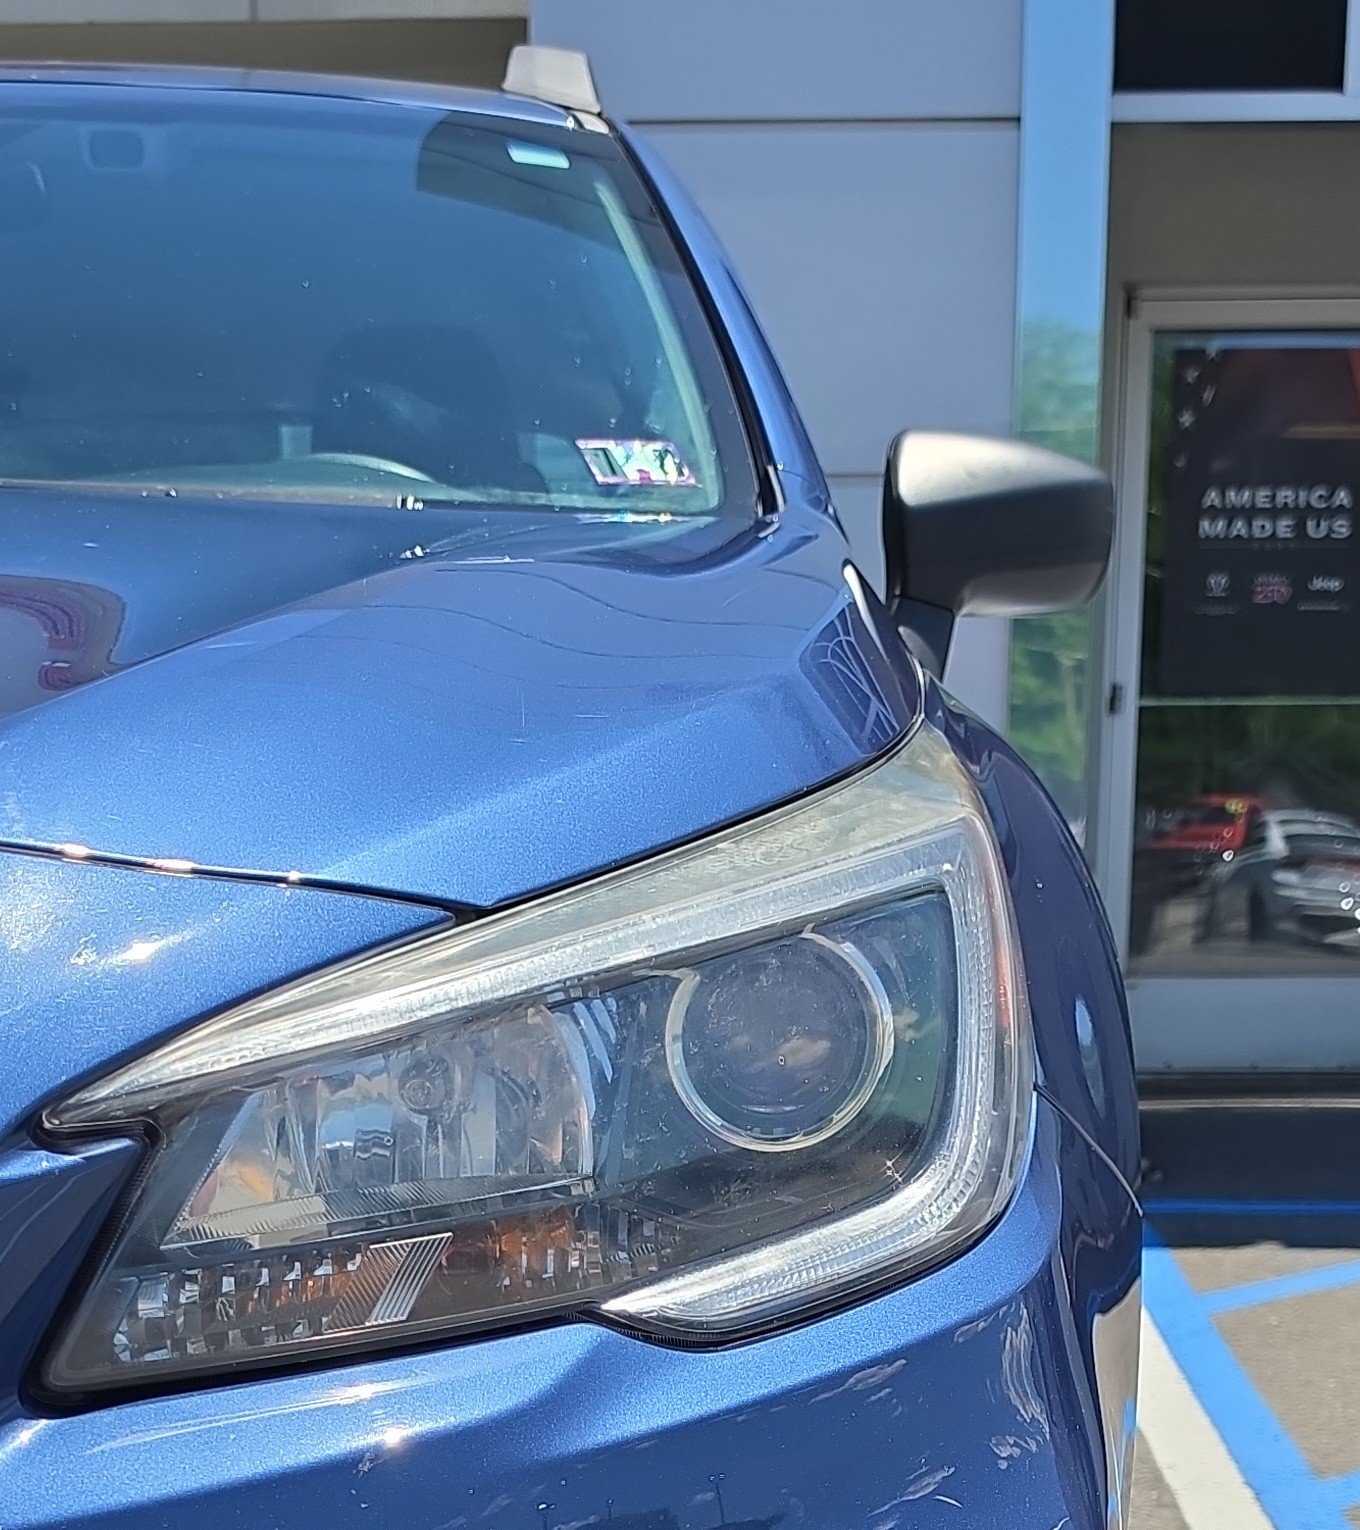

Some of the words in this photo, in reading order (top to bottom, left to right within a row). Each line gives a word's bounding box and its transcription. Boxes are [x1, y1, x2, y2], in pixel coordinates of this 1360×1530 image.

[1201, 485, 1354, 509] AMERICA
[1198, 516, 1297, 539] MADE
[1306, 516, 1353, 539] US
